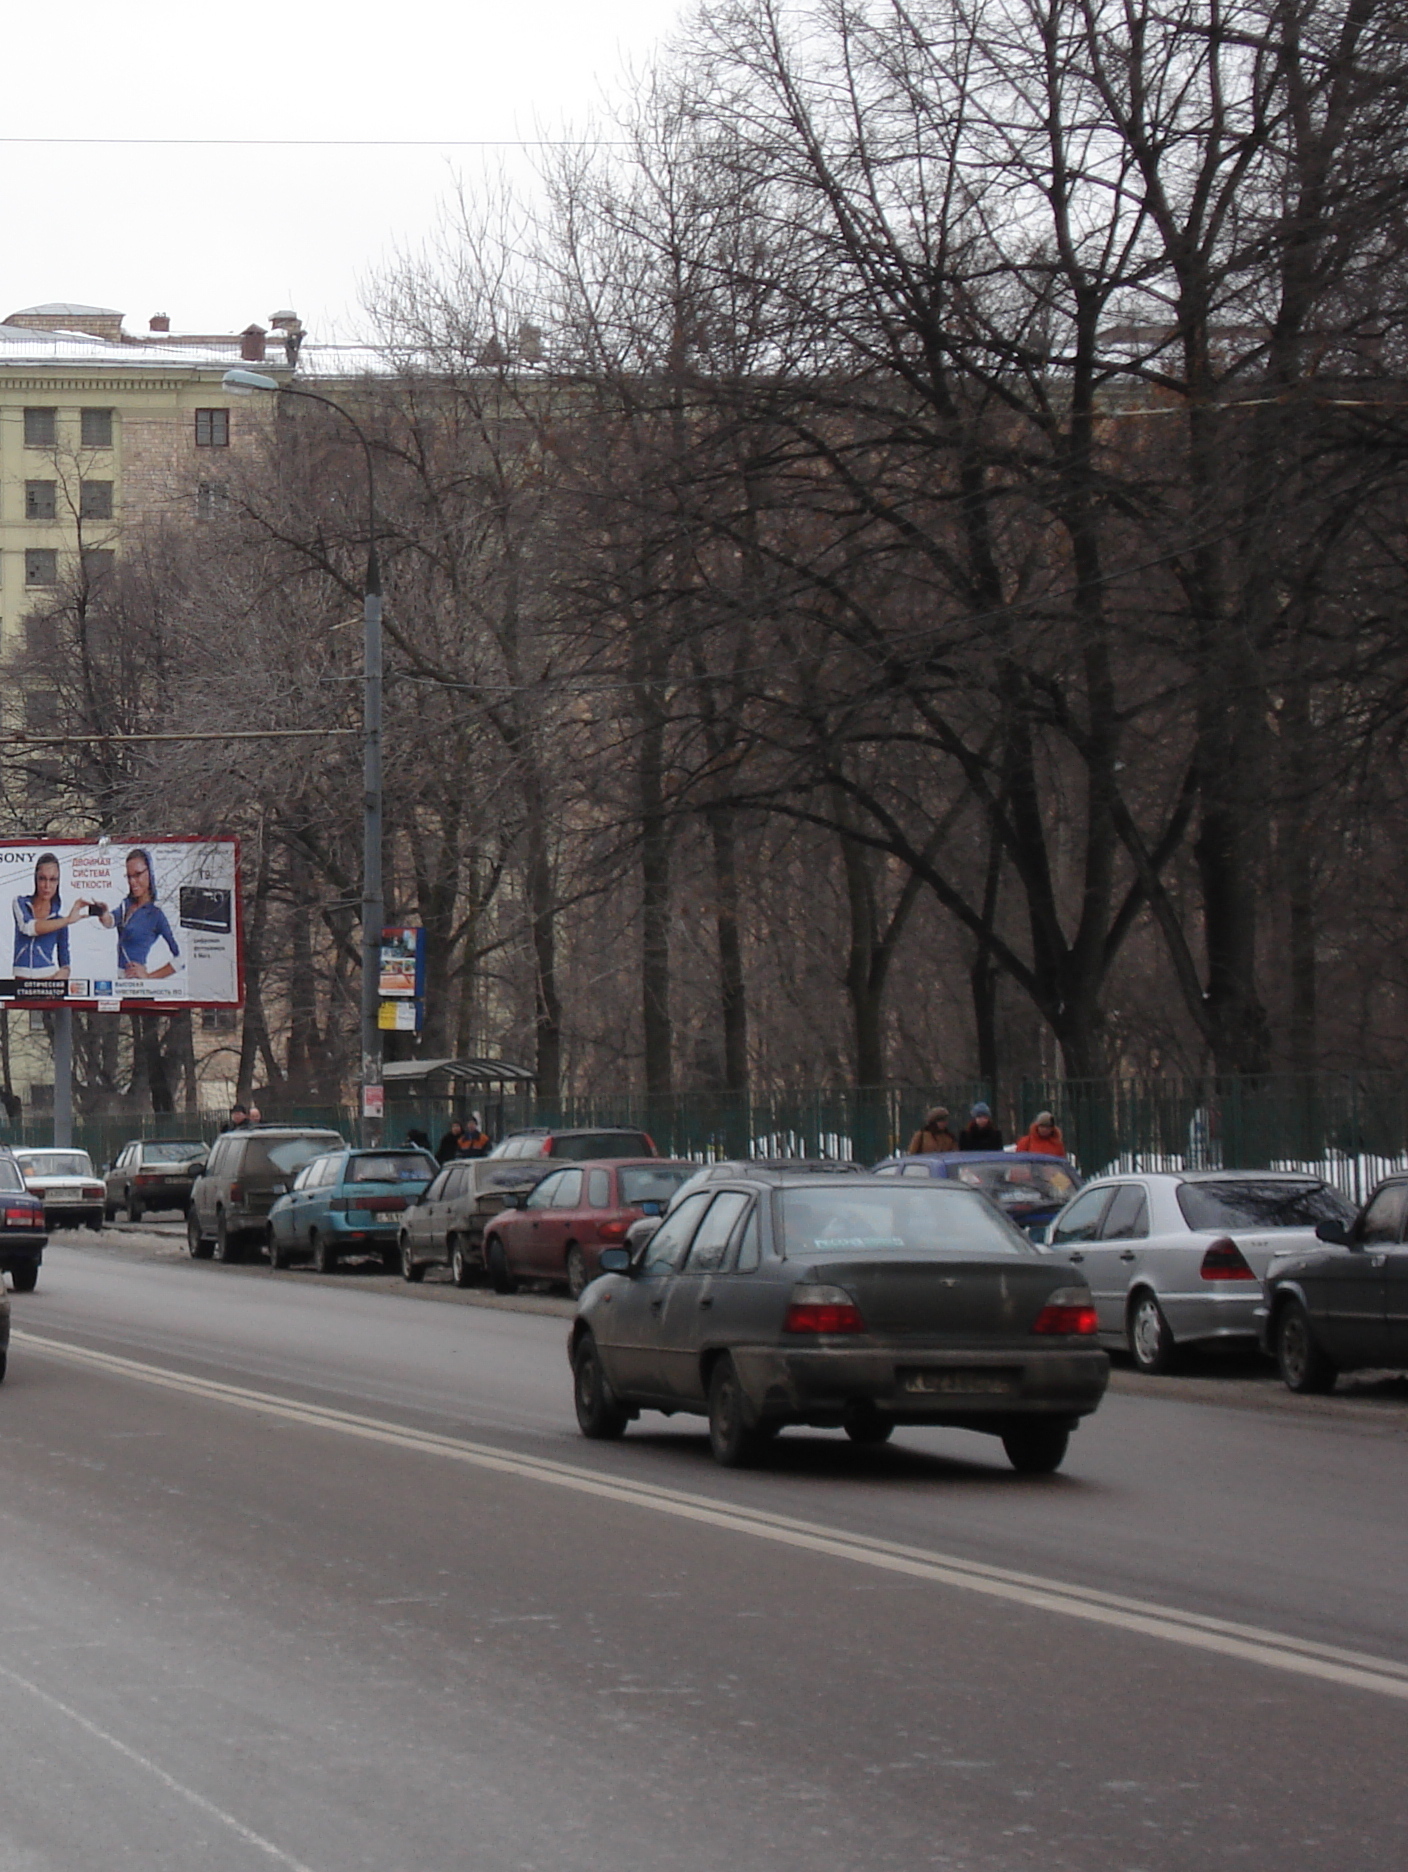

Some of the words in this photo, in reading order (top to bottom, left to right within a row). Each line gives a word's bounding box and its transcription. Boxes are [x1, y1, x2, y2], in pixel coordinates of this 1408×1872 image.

[73, 858, 111, 867] ДВОЙНАЯ
[73, 869, 110, 877] СИСТЕМА
[71, 880, 112, 889] ЧЕТКОСТИ
